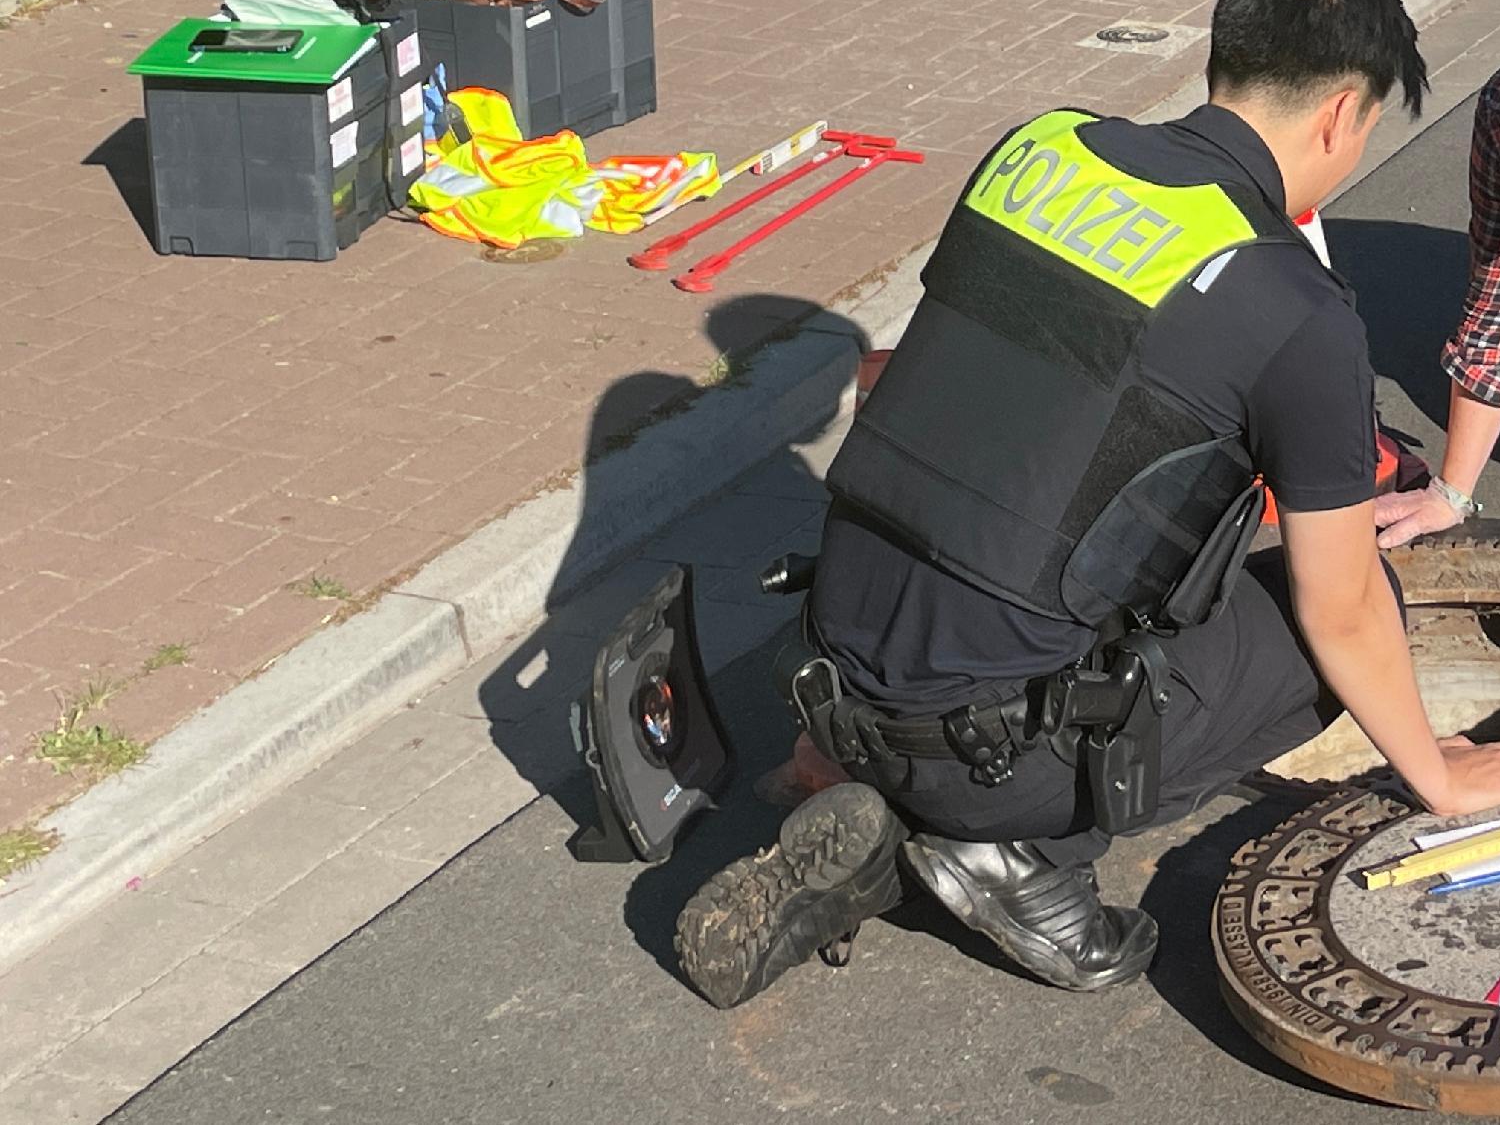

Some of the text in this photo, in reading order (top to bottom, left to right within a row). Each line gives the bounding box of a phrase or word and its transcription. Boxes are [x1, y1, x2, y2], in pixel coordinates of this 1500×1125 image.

[979, 138, 1185, 280] POLIZEI
[1223, 915, 1257, 969] KLASSE
[1288, 1002, 1323, 1026] DIN
